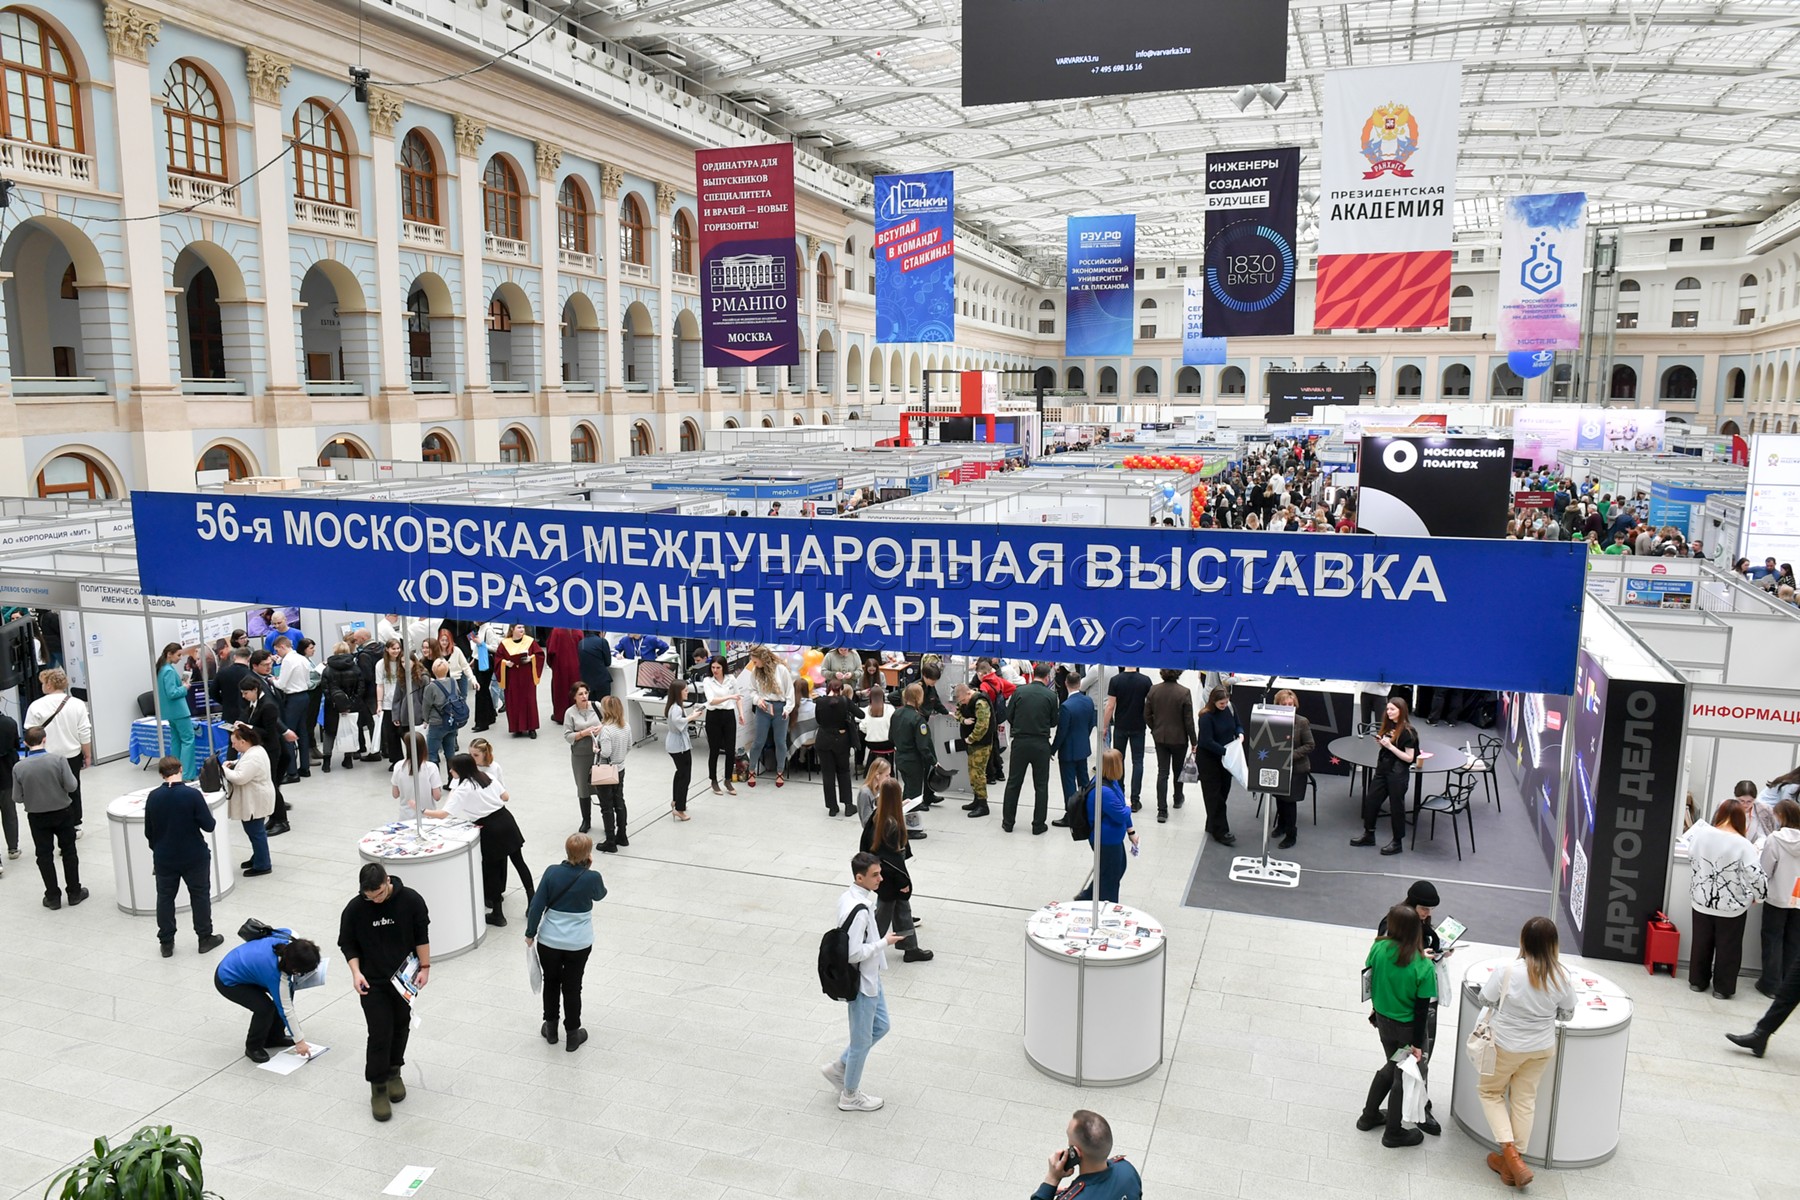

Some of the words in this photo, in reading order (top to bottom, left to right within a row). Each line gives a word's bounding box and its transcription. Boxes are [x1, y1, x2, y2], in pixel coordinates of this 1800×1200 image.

[1056, 56, 1099, 65] VARVARKA3.ru
[1135, 47, 1191, 58] info@varvarka3.ru
[1091, 66, 1099, 74] +7
[1100, 65, 1112, 73] 495
[1113, 64, 1124, 72] 698
[702, 160, 759, 171] ОРДИНАТУРА
[760, 158, 778, 168] ДЛЯ
[1209, 159, 1279, 172] ИНЖЕНЕРЫ
[1373, 161, 1404, 172] РАНХиГС
[703, 174, 768, 187] ВЫПУСКНИКОВ
[1209, 177, 1268, 190] СОЗДАЮТ
[703, 189, 772, 201] СПЕЦИАЛИТЕТА
[1331, 186, 1445, 199] ПРЕЗИДЕНТСКАЯ
[901, 196, 948, 208] СТАНКИН
[1209, 195, 1266, 207] БУДУЩЕЕ
[712, 205, 746, 216] ВРАЧЕЙ
[757, 203, 789, 213] НОВЫЕ
[1331, 199, 1444, 221] АКАДЕМИЯ
[704, 221, 759, 231] ГОРИЗОНТЫ!
[878, 219, 917, 245] ВСТУПАЙ
[1080, 231, 1121, 241] РЭУ.РФ
[888, 247, 895, 259] В
[897, 230, 939, 255] КОМАНДУ
[903, 243, 951, 271] СТАНКИНА!
[1079, 257, 1122, 265] РОССИЙСКИЙ
[1071, 266, 1129, 274] ЭКОНОМИЧЕСКИЙ
[1226, 254, 1276, 274] 1830
[1227, 272, 1275, 285] BMSTU
[711, 294, 787, 312] РМАНПО
[728, 331, 773, 343] МОСКВА
[2, 537, 14, 545] АО
[15, 530, 68, 544] «КОРПОРАЦИЯ
[69, 528, 92, 538] «МИТ»
[195, 501, 273, 544] 56-я
[283, 510, 569, 561] МОСКОВСКАЯ
[582, 525, 1063, 588] МЕЖДУНАРОДНАЯ
[1086, 544, 1447, 602] ВЫСТАВКА
[21, 585, 49, 595] ОБУЧЕНИЕ
[80, 584, 142, 596] ПОЛИТЕХНИЧЕСКИ
[101, 596, 126, 605] ИМЕНИ
[397, 568, 756, 628] «ОБРАЗОВАНИЕ
[774, 590, 805, 630] И
[825, 593, 1106, 647] КАРЬЕРА»
[1618, 690, 1657, 802] ДЕЛО
[1604, 806, 1646, 955] ДРУГОЕ
